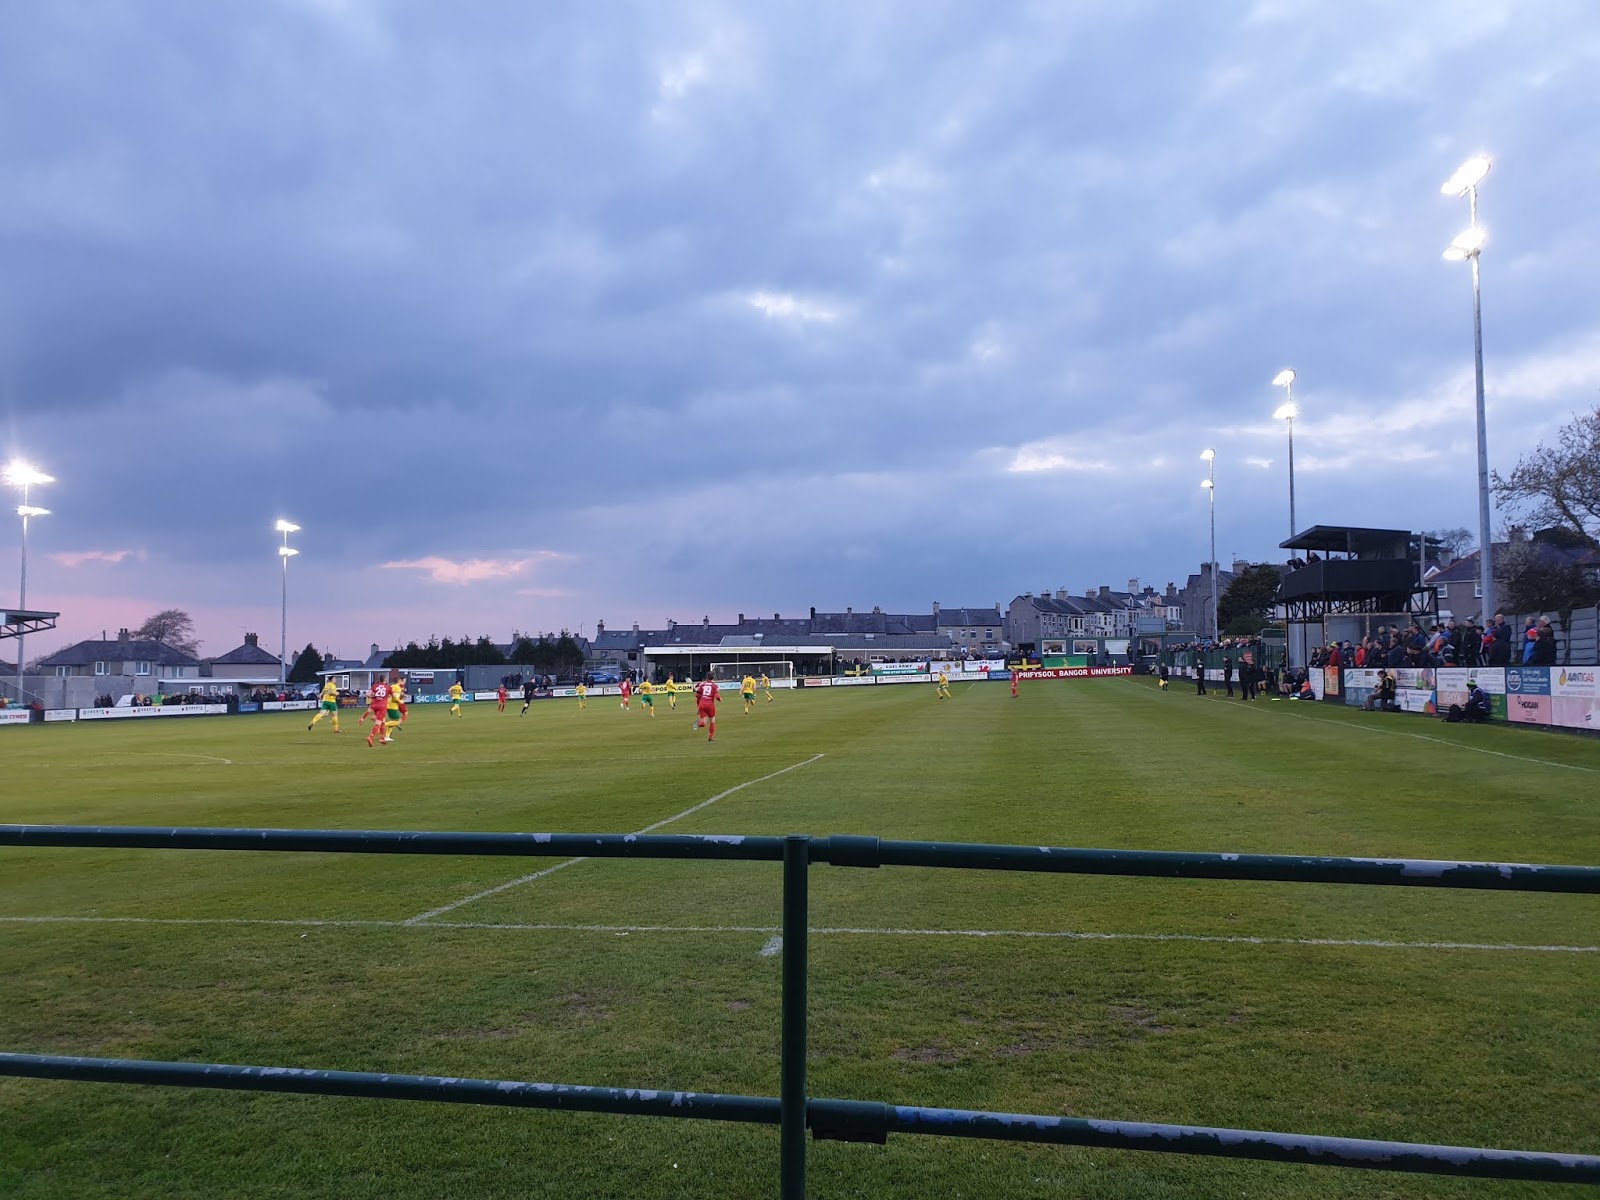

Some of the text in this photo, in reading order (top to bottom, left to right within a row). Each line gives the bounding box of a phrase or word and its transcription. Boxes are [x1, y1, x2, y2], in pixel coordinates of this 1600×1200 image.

[1091, 667, 1132, 675] UNIVERSITY
[375, 687, 387, 697] 26
[702, 685, 712, 695] 19
[436, 694, 449, 702] S4C
[1521, 701, 1539, 709] HOGAN
